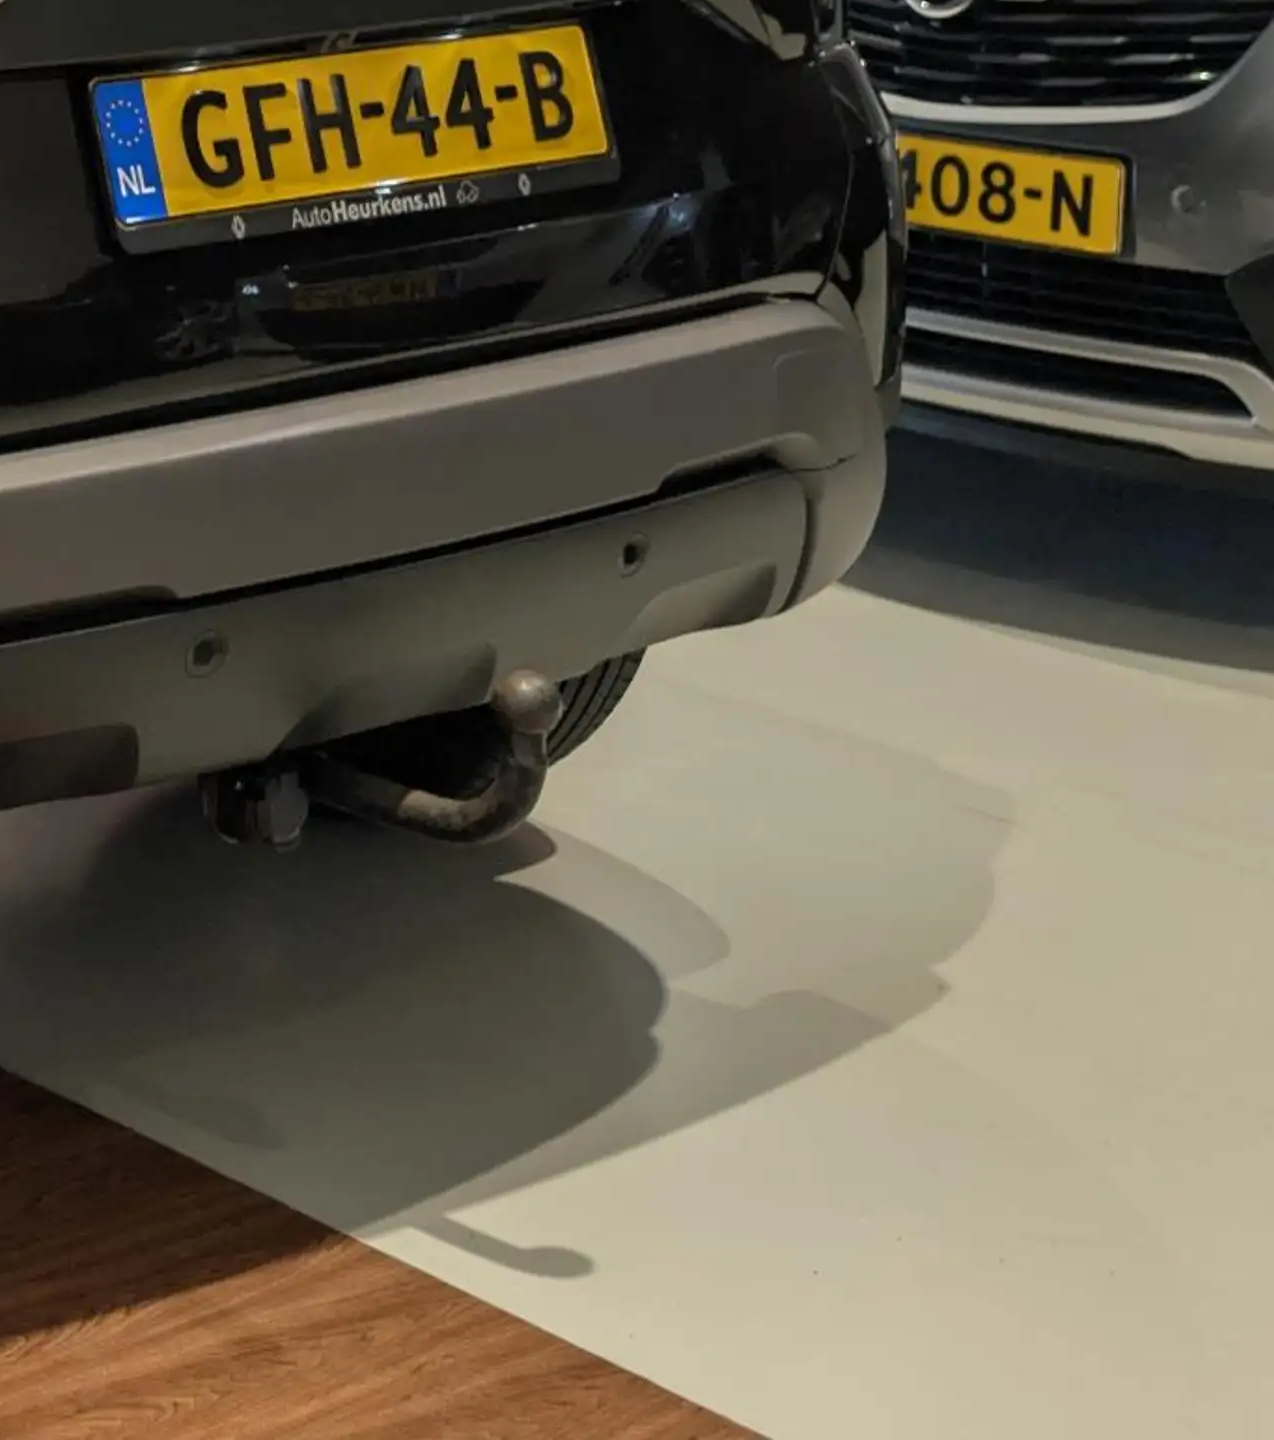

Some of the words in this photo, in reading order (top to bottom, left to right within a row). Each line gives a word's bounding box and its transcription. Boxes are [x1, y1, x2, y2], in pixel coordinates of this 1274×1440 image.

[180, 50, 574, 190] GFH-44-B
[117, 167, 156, 199] NL
[291, 184, 448, 230] AutoHeurkens.nl
